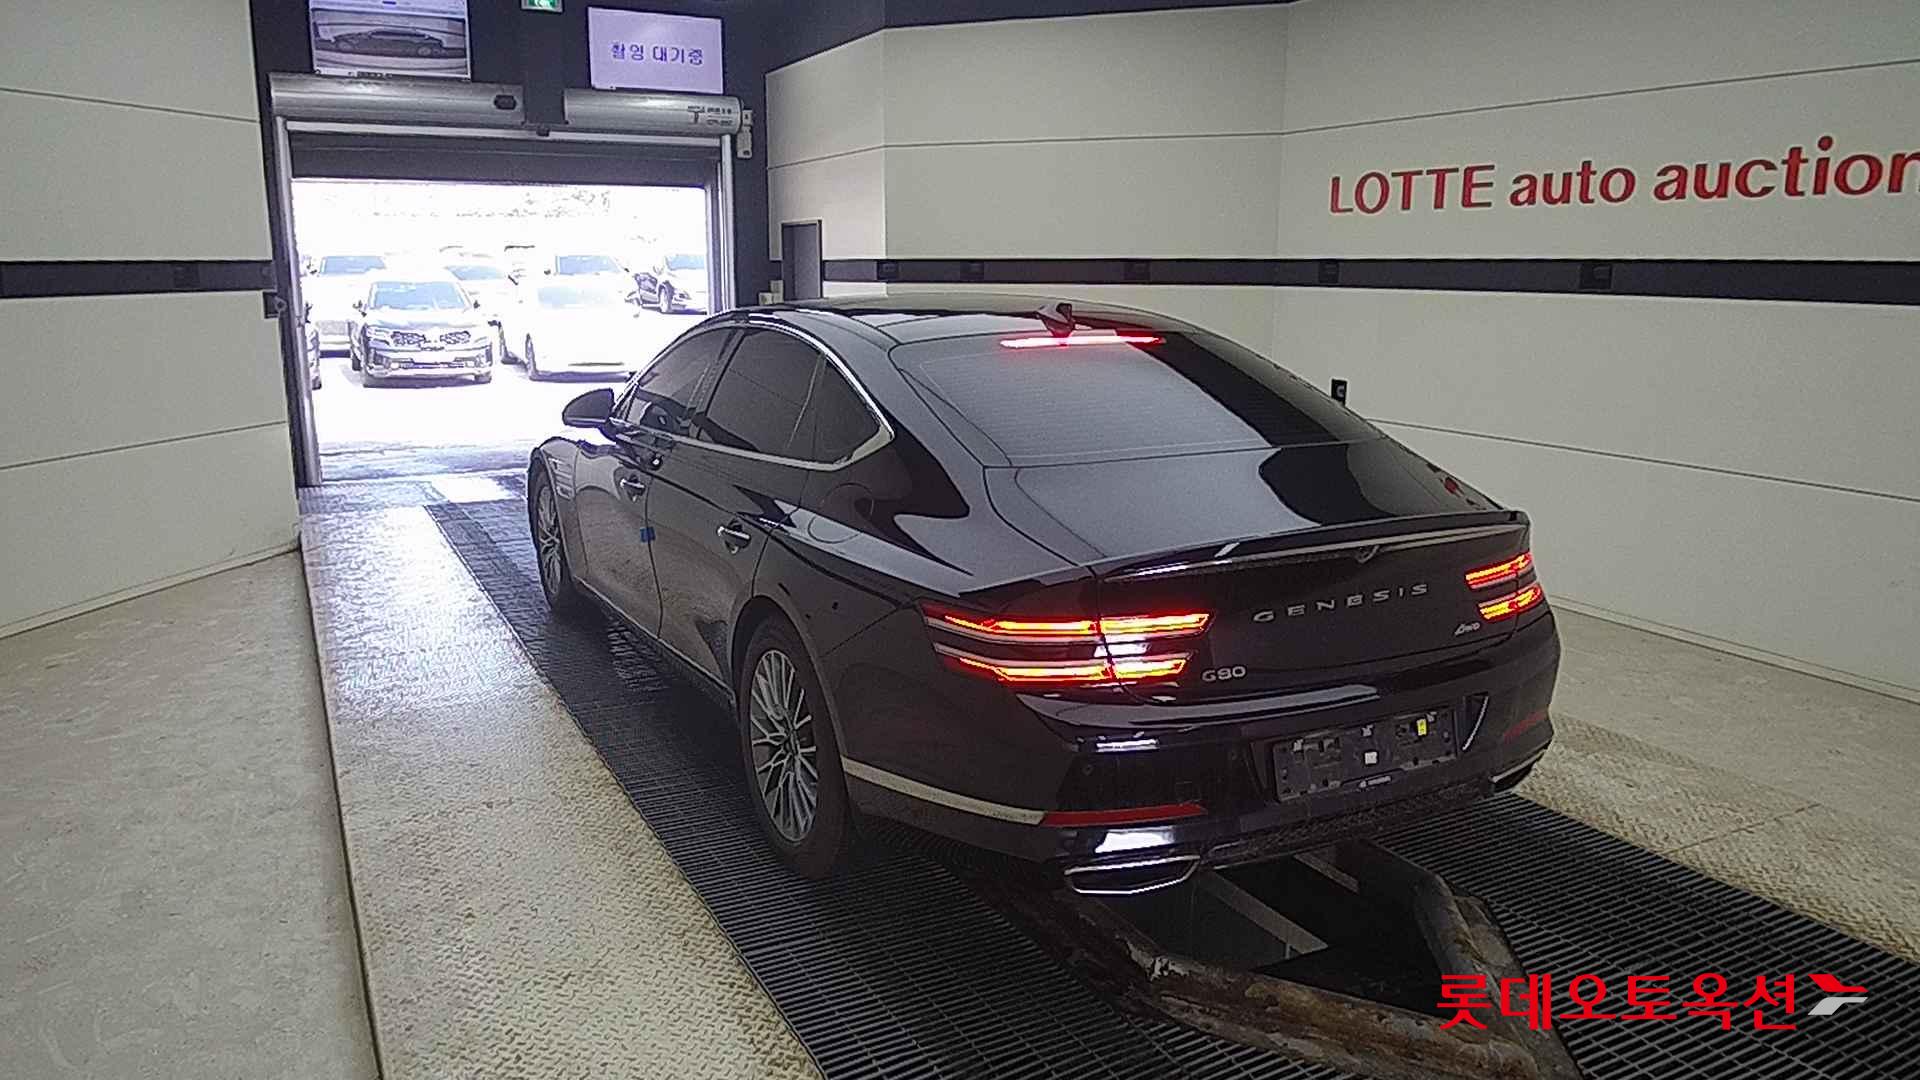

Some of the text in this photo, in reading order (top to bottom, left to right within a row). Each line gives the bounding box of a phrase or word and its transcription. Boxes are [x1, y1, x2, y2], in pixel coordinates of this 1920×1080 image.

[652, 45, 704, 66] 대기중
[1330, 164, 1496, 214] LOTTE
[1510, 160, 1636, 206] auto
[1252, 583, 1428, 623] GENESIS
